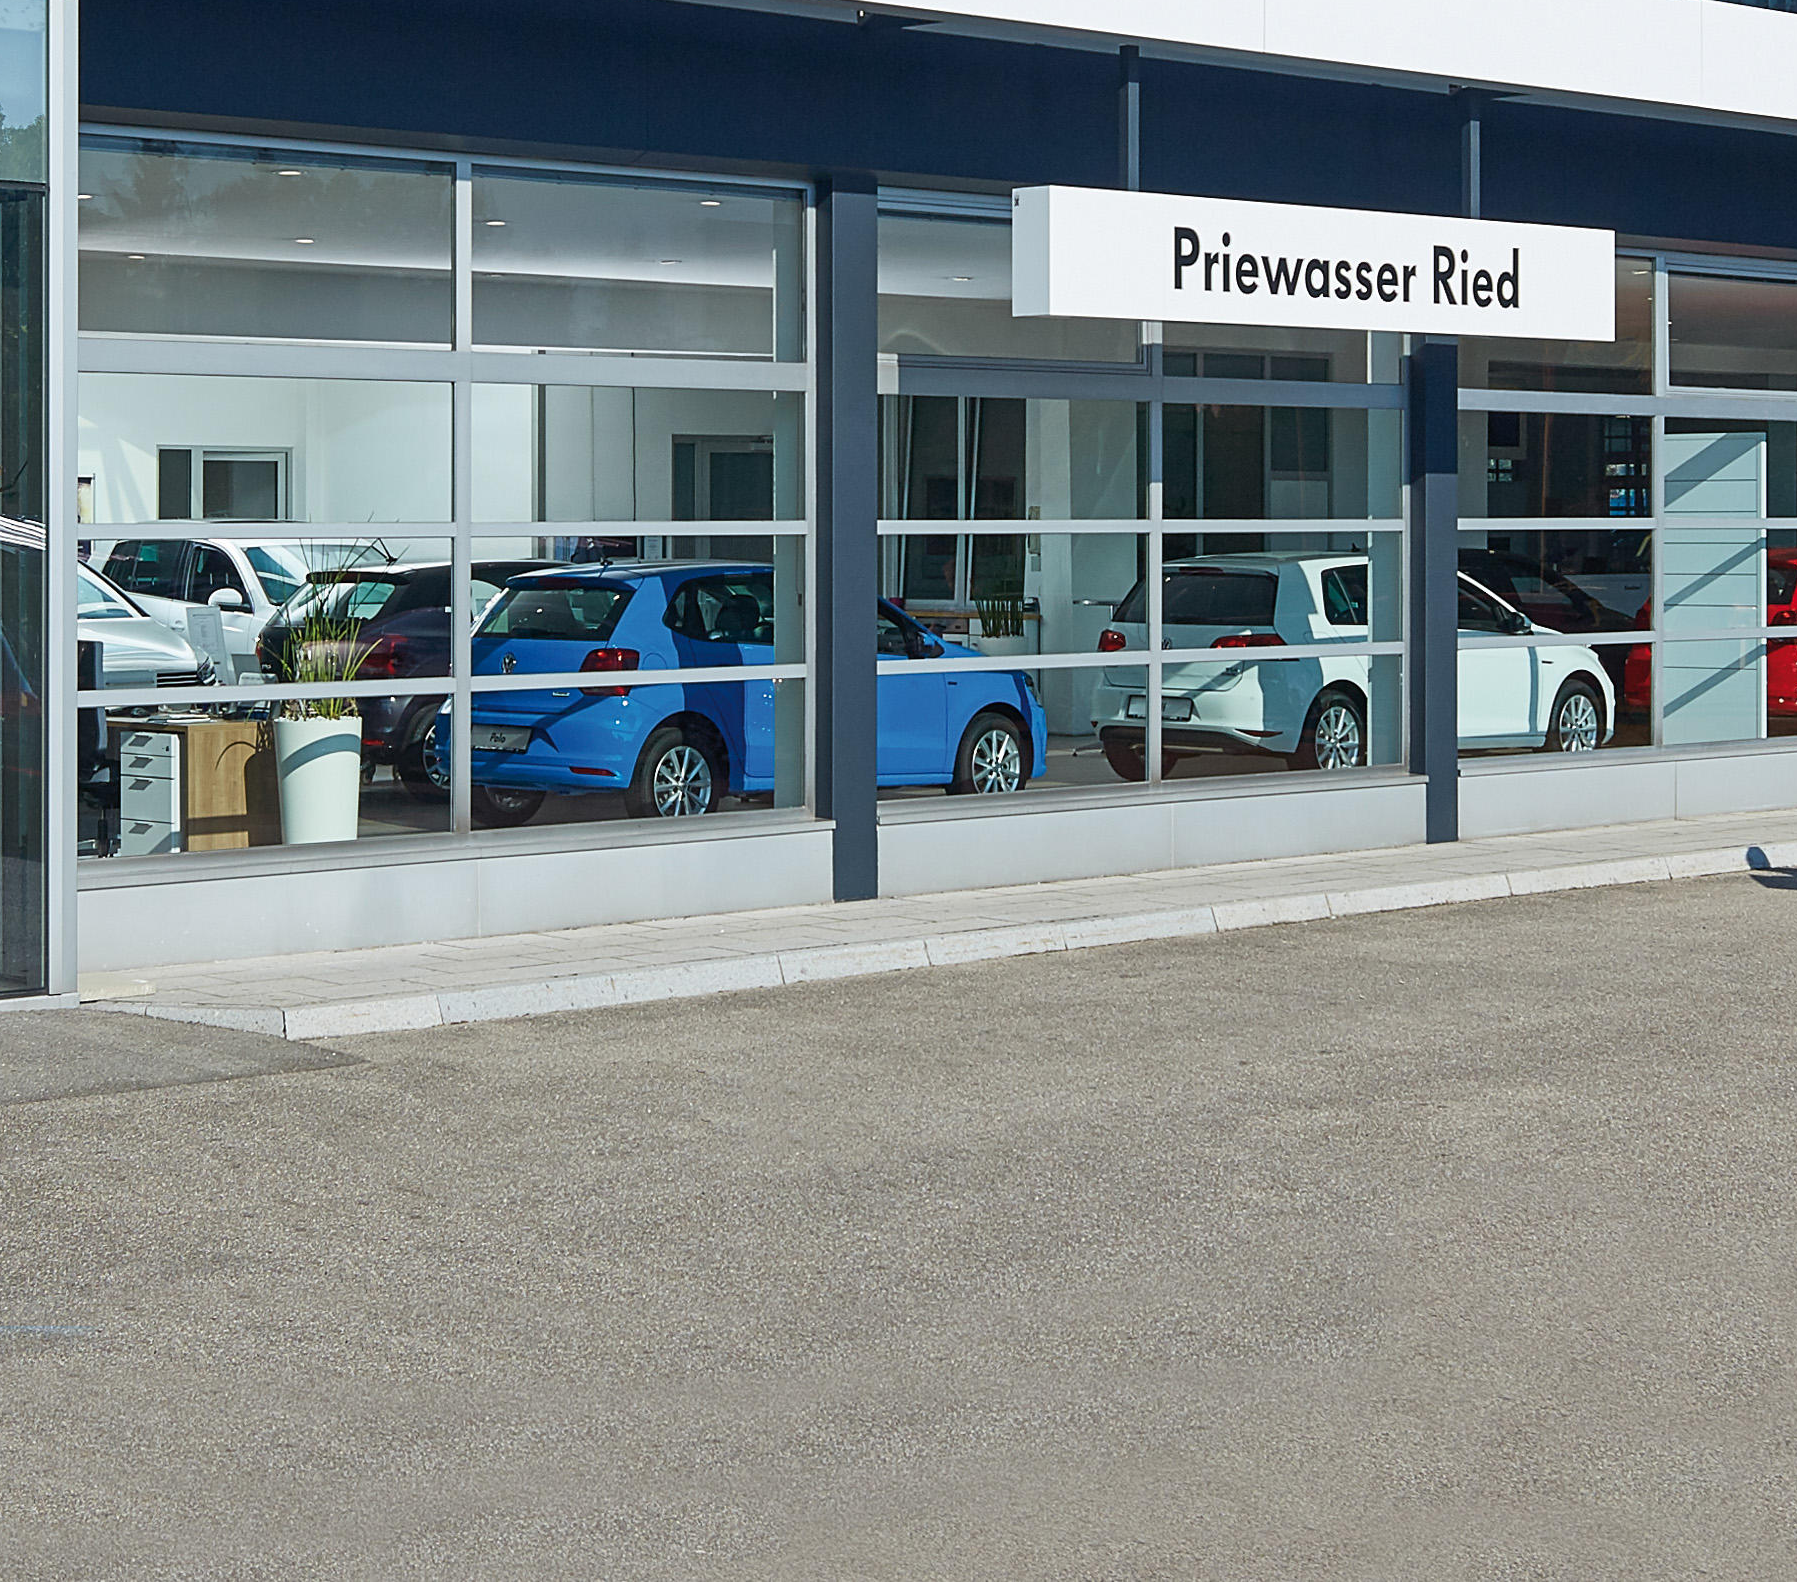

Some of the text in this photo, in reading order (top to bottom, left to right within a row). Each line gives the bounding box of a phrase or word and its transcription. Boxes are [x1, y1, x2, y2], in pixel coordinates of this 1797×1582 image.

[1174, 226, 1520, 308] Priewasser Ried
[489, 732, 507, 743] Polo
